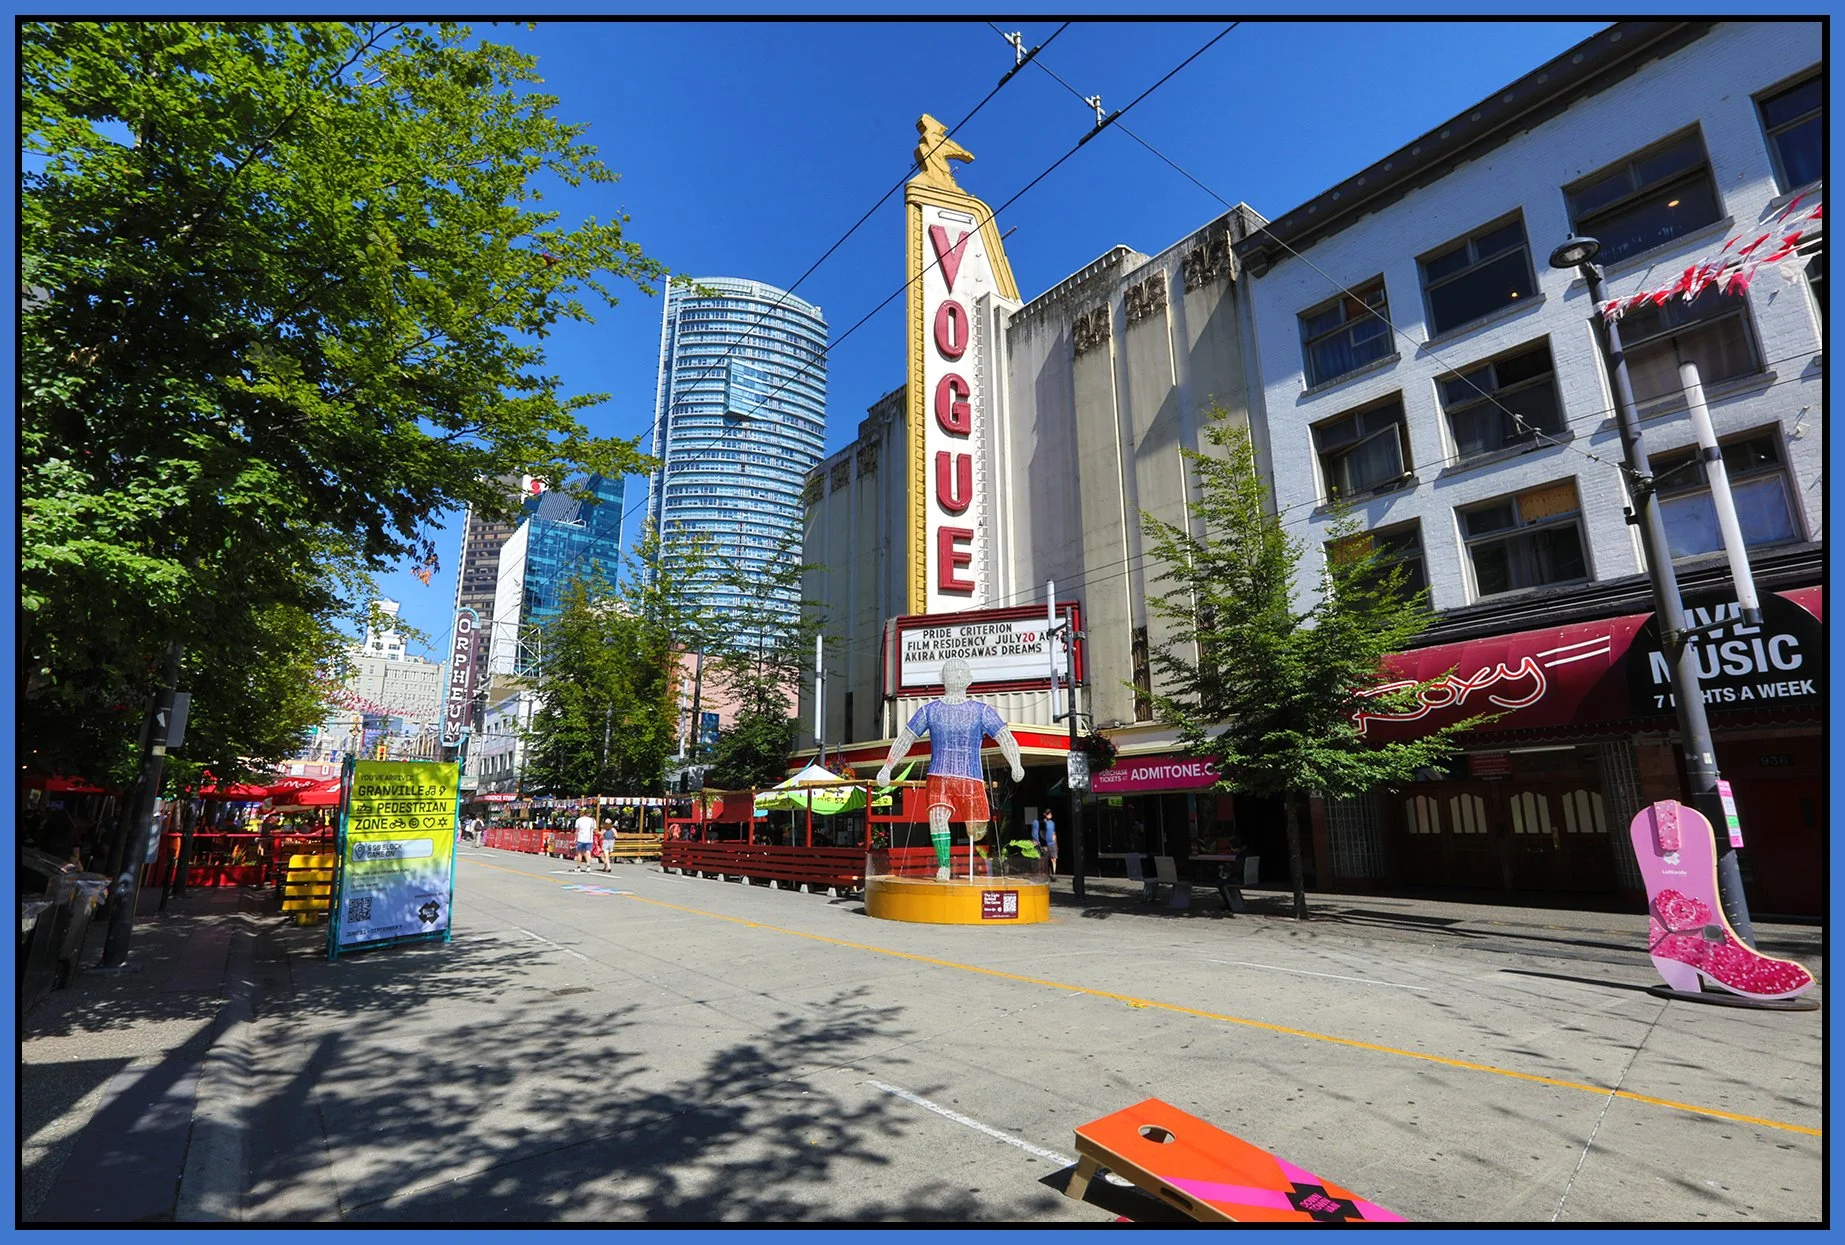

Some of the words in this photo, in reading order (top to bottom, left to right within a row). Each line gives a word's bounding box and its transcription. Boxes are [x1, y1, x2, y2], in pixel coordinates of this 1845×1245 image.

[928, 223, 976, 593] VOGUE
[1684, 601, 1761, 642] IVE
[923, 628, 952, 639] PRIDE
[960, 623, 1012, 637] CRITERION
[907, 640, 930, 651] FILM
[933, 635, 986, 650] RESIDENCY
[905, 651, 935, 662] AKIRA
[938, 647, 998, 660] KUROSAWAS
[1001, 643, 1042, 655] DREAMS
[1648, 633, 1803, 685] MUSIC
[446, 618, 471, 736] ORPHEUM
[1653, 695, 1665, 709] 7
[1740, 686, 1755, 701] A
[1757, 679, 1817, 699] WEEK
[1099, 775, 1122, 783] TICKETS
[1130, 762, 1222, 781] ADMITONE.C
[358, 785, 425, 797] GRANVILLE
[376, 802, 447, 814] PEDESTRIAN
[355, 818, 388, 830] ZONE
[366, 851, 384, 859] GAME
[1308, 1197, 1331, 1212] TOWN
